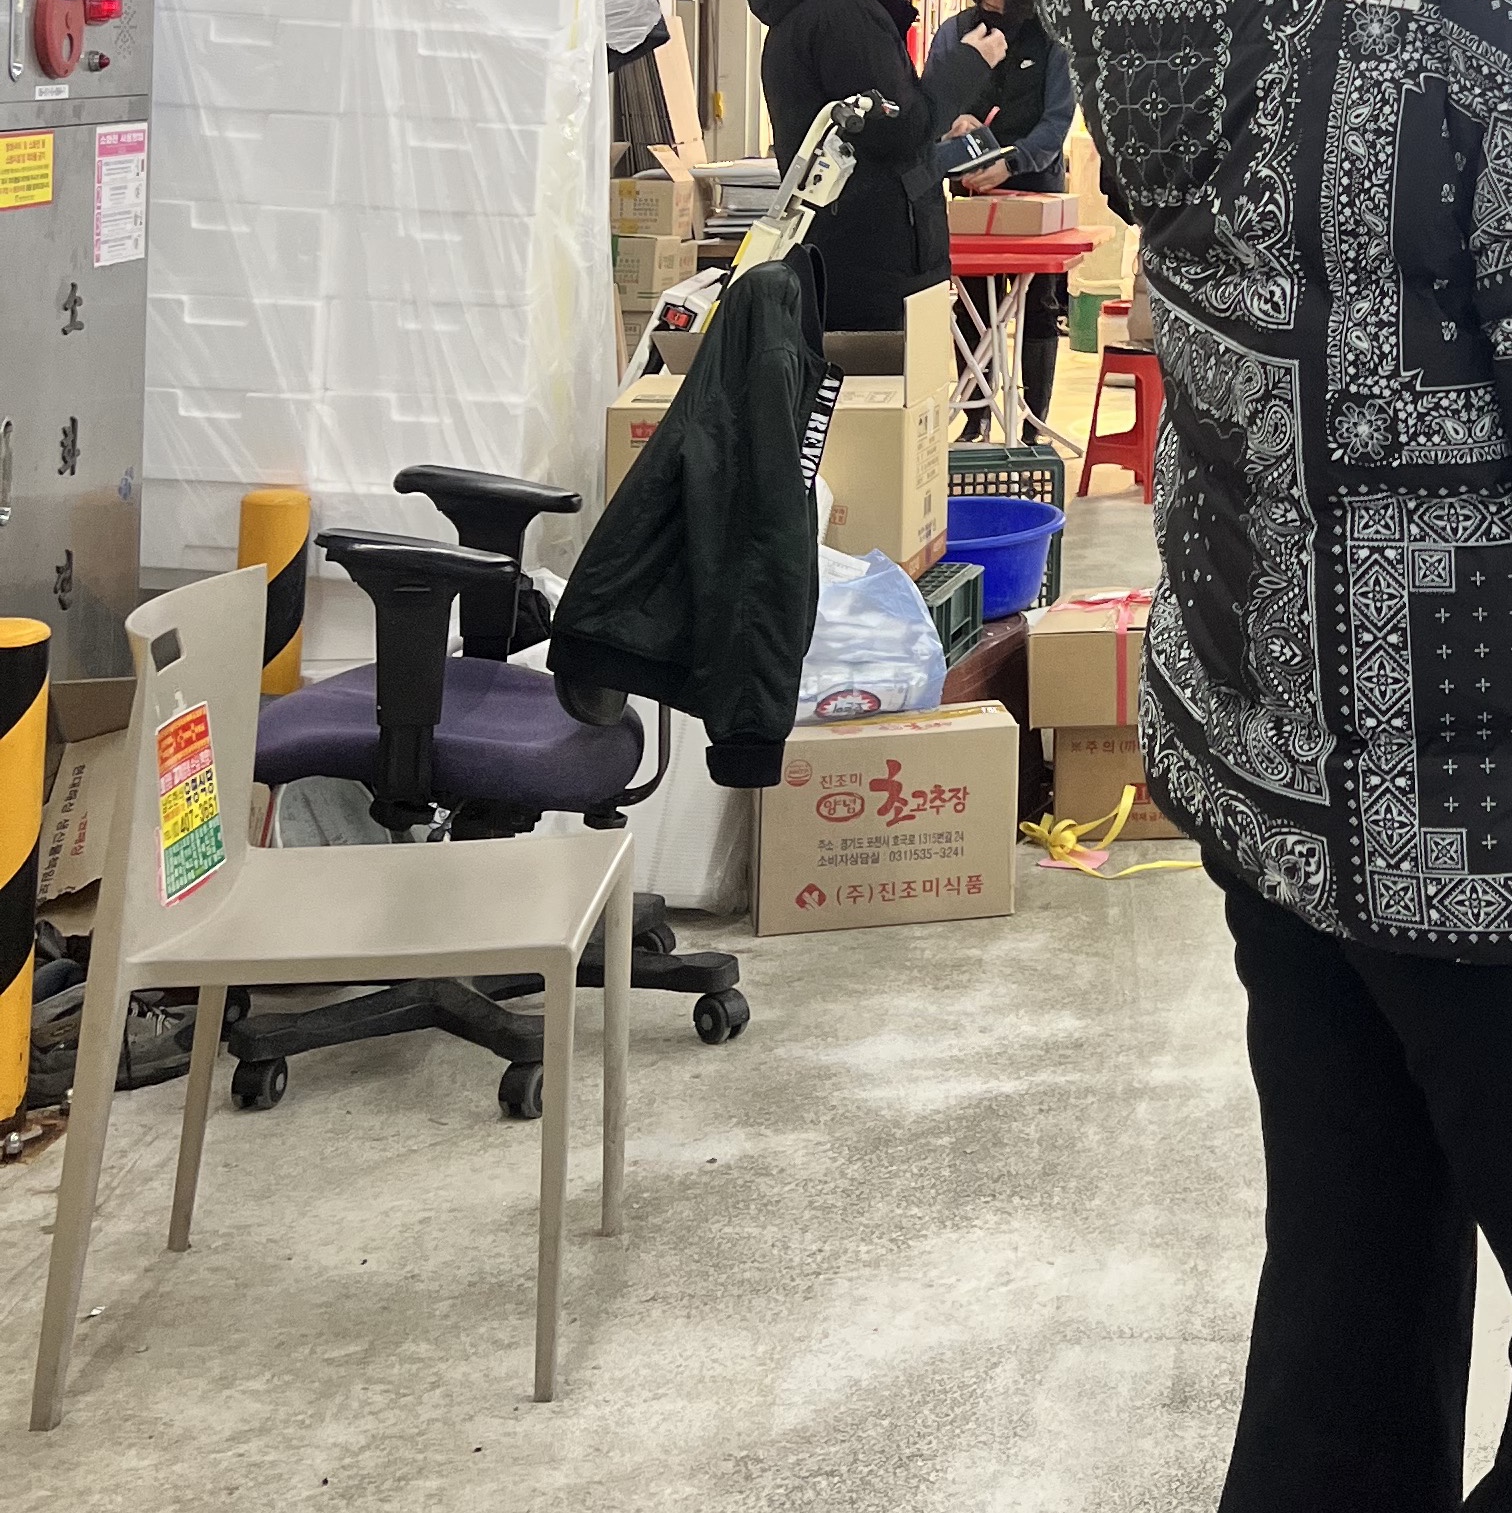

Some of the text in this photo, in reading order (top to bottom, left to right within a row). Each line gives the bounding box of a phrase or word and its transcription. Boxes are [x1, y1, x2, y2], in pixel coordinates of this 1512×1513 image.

[800, 411, 831, 496] REVO
[819, 759, 970, 828] 진조미 초고추장
[823, 796, 857, 816] 양념
[817, 839, 834, 852] 주소
[840, 838, 864, 851] 경기도
[866, 836, 890, 849] 포천시
[891, 834, 916, 846] 호국로
[817, 846, 965, 867] 소비자상담실 031)535-3241
[835, 874, 985, 906] (주)진조미식품
